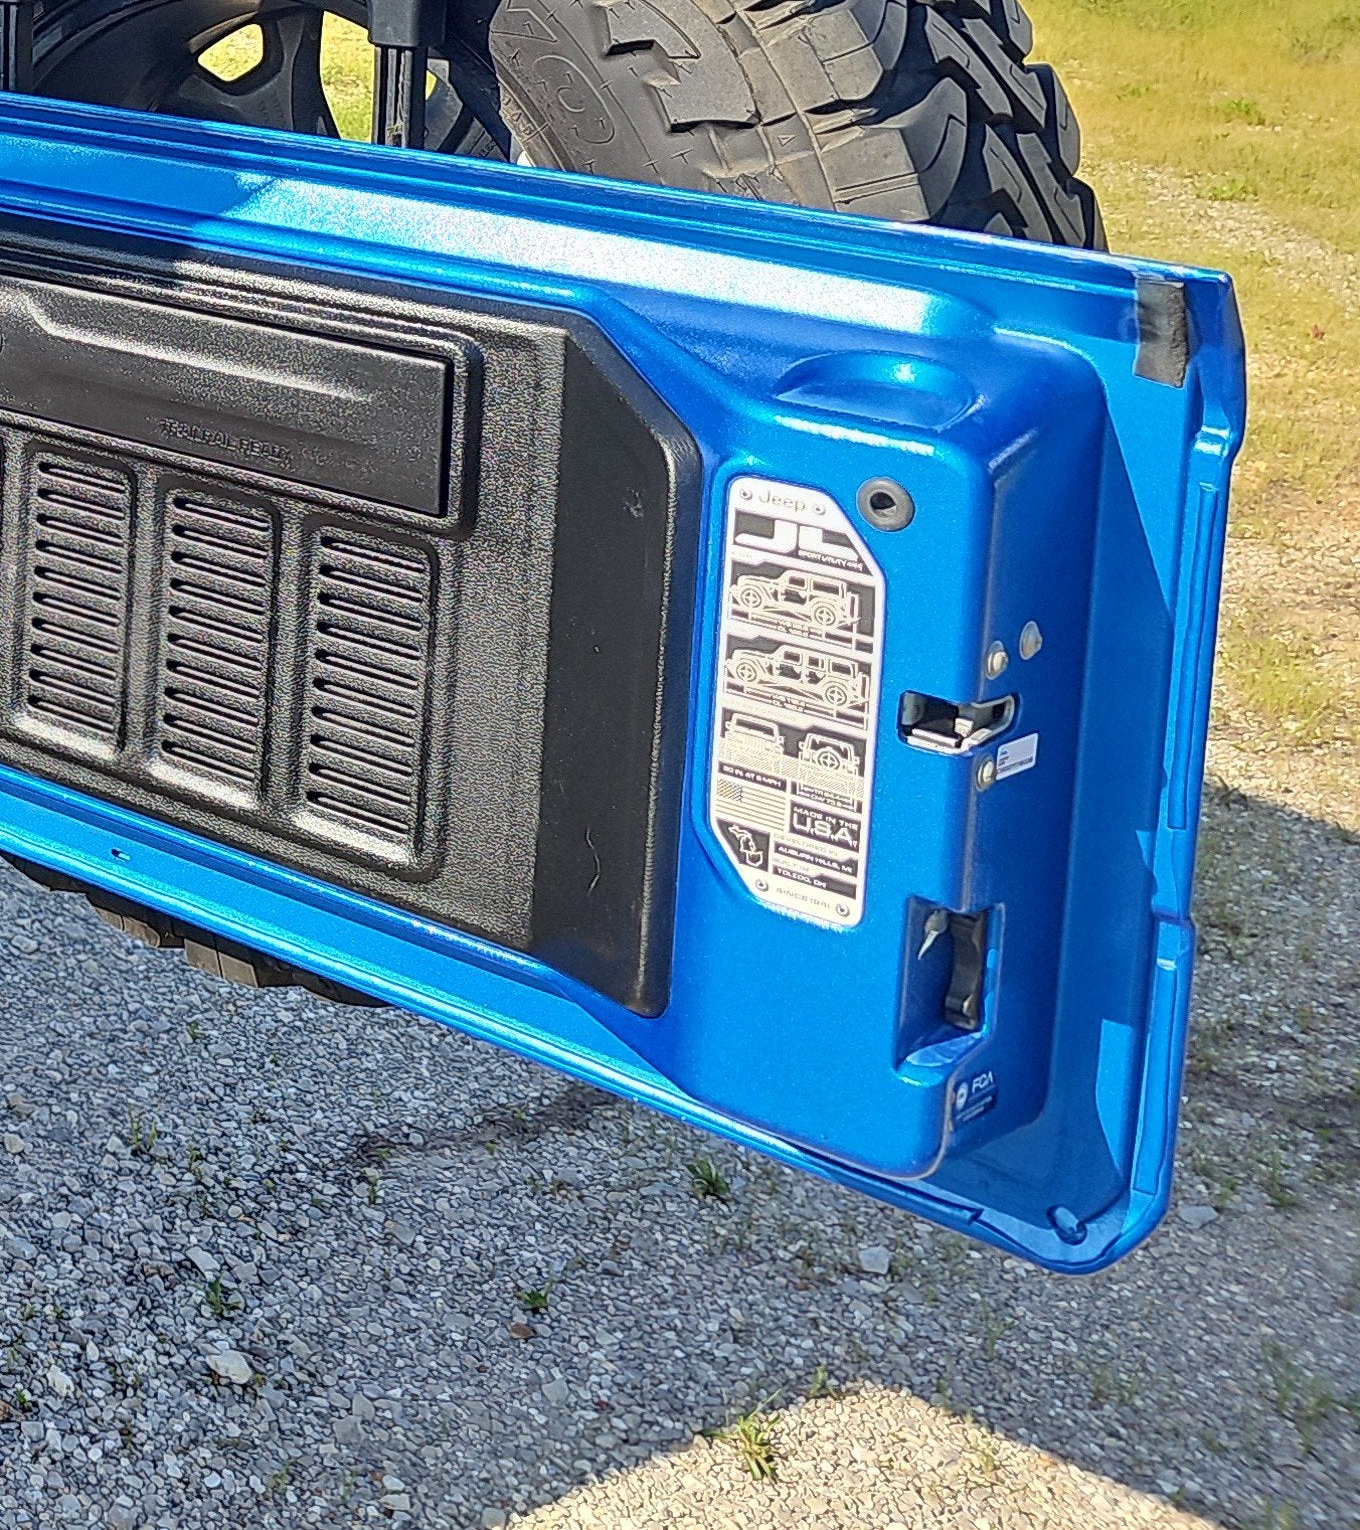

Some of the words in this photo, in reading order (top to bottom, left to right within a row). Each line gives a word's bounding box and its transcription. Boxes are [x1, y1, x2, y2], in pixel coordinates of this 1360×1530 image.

[758, 490, 806, 513] Jeep
[735, 519, 860, 562] JL
[793, 806, 823, 820] MADE
[839, 820, 858, 831] THE
